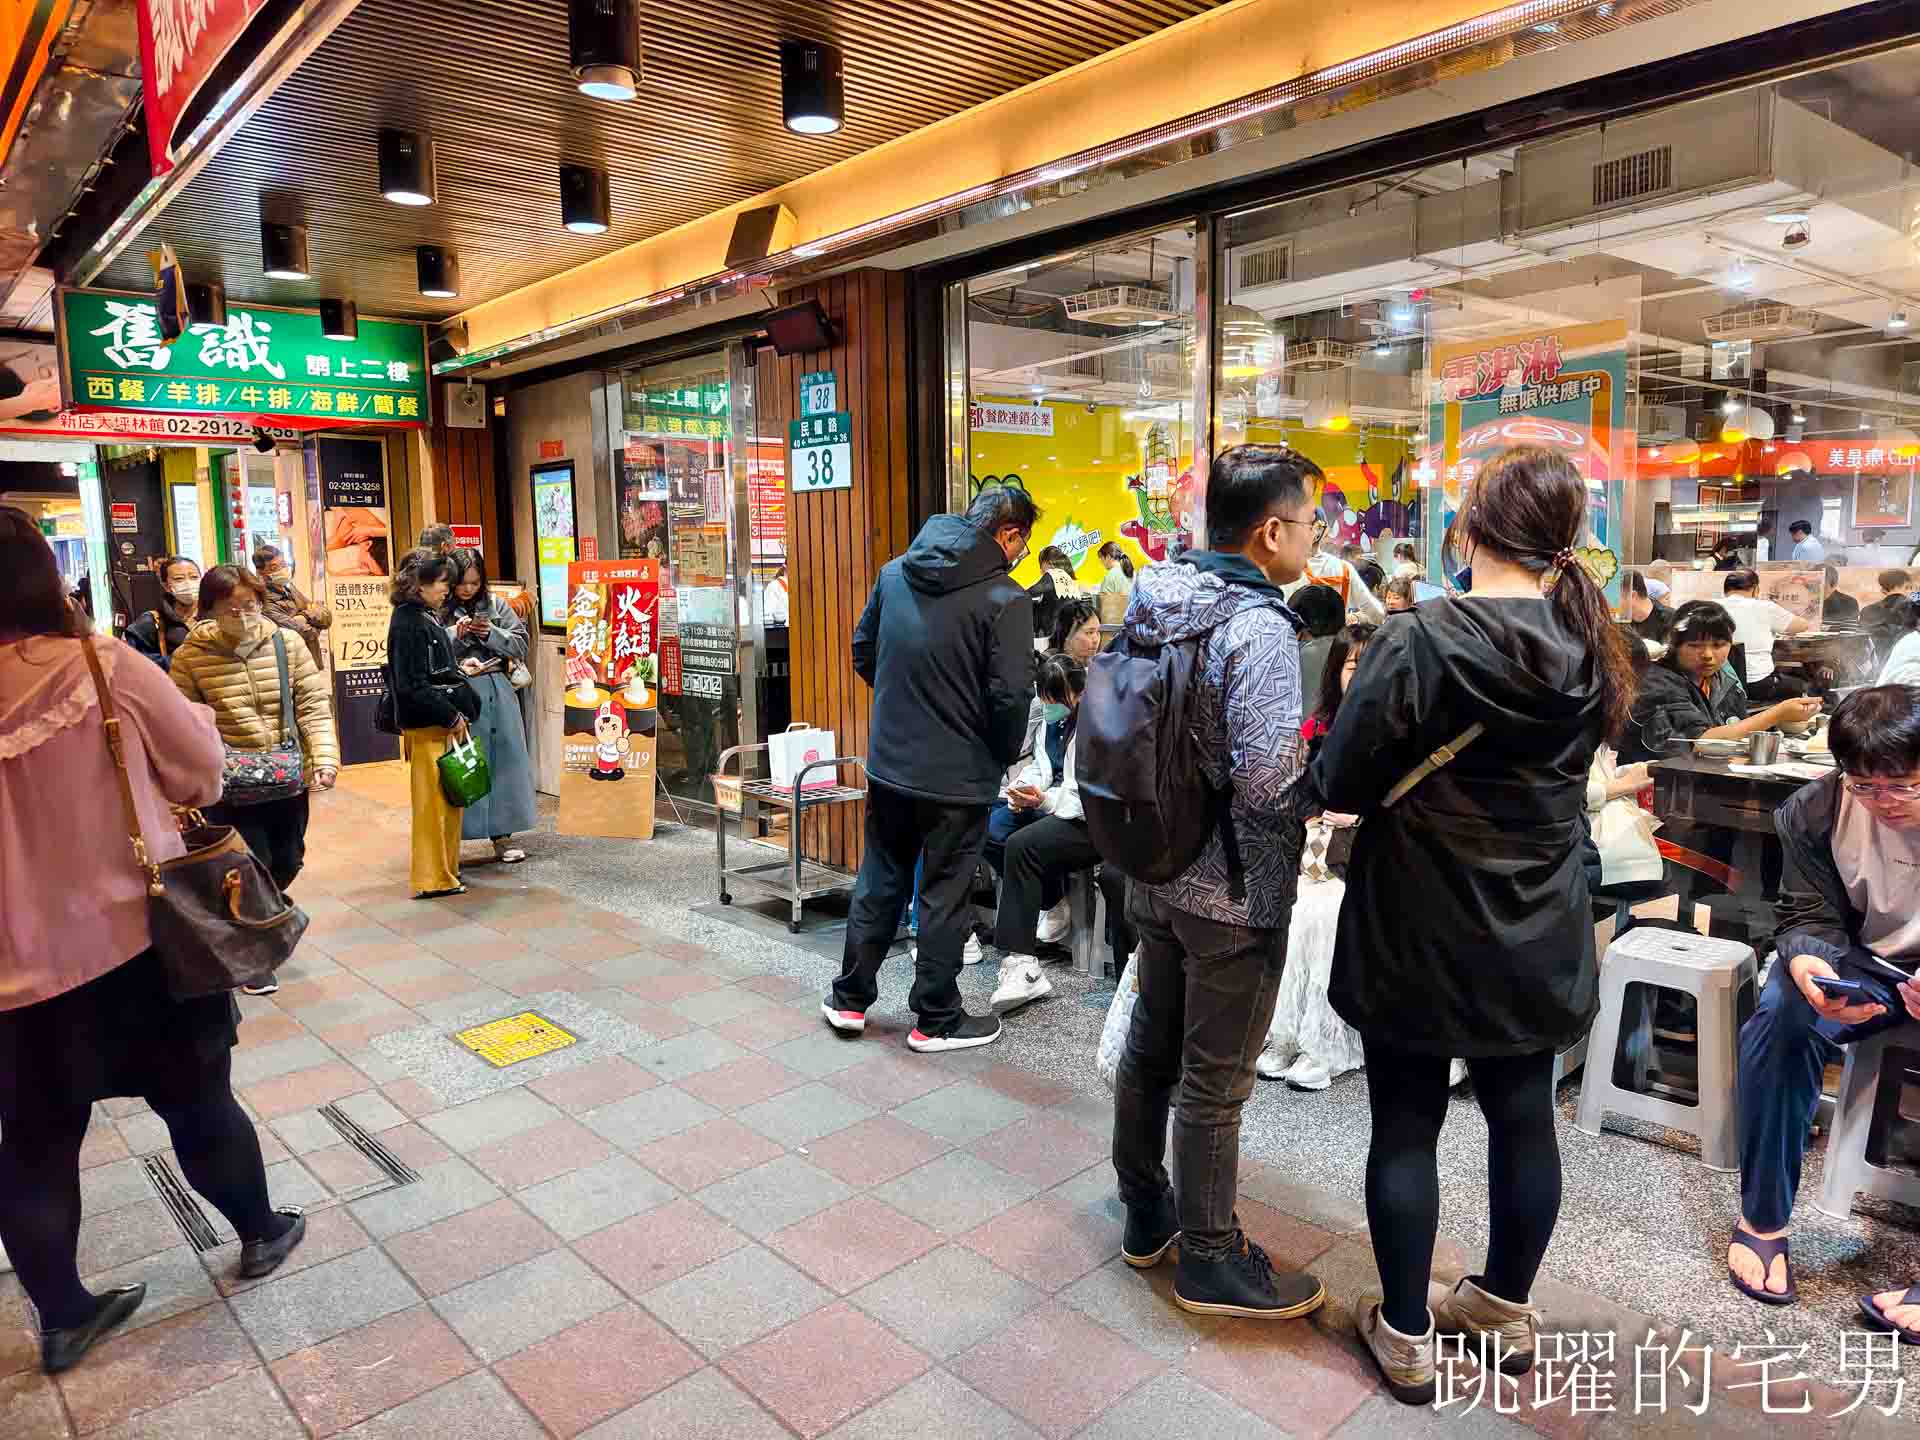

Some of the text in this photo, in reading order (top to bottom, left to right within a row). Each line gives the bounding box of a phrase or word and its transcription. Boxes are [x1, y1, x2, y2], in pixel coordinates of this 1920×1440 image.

[89, 300, 286, 380] 舊識
[305, 354, 410, 383] 請上二樓
[1441, 337, 1562, 402] 霜淇淋
[815, 386, 830, 410] 38
[1499, 376, 1601, 414] 無限供應中
[57, 413, 165, 433] 新店大坪林館
[986, 409, 1051, 427] 餐飲連鎖企業
[807, 448, 834, 486] 38
[328, 481, 381, 492] 02-2912-3258
[336, 599, 367, 611] SPA
